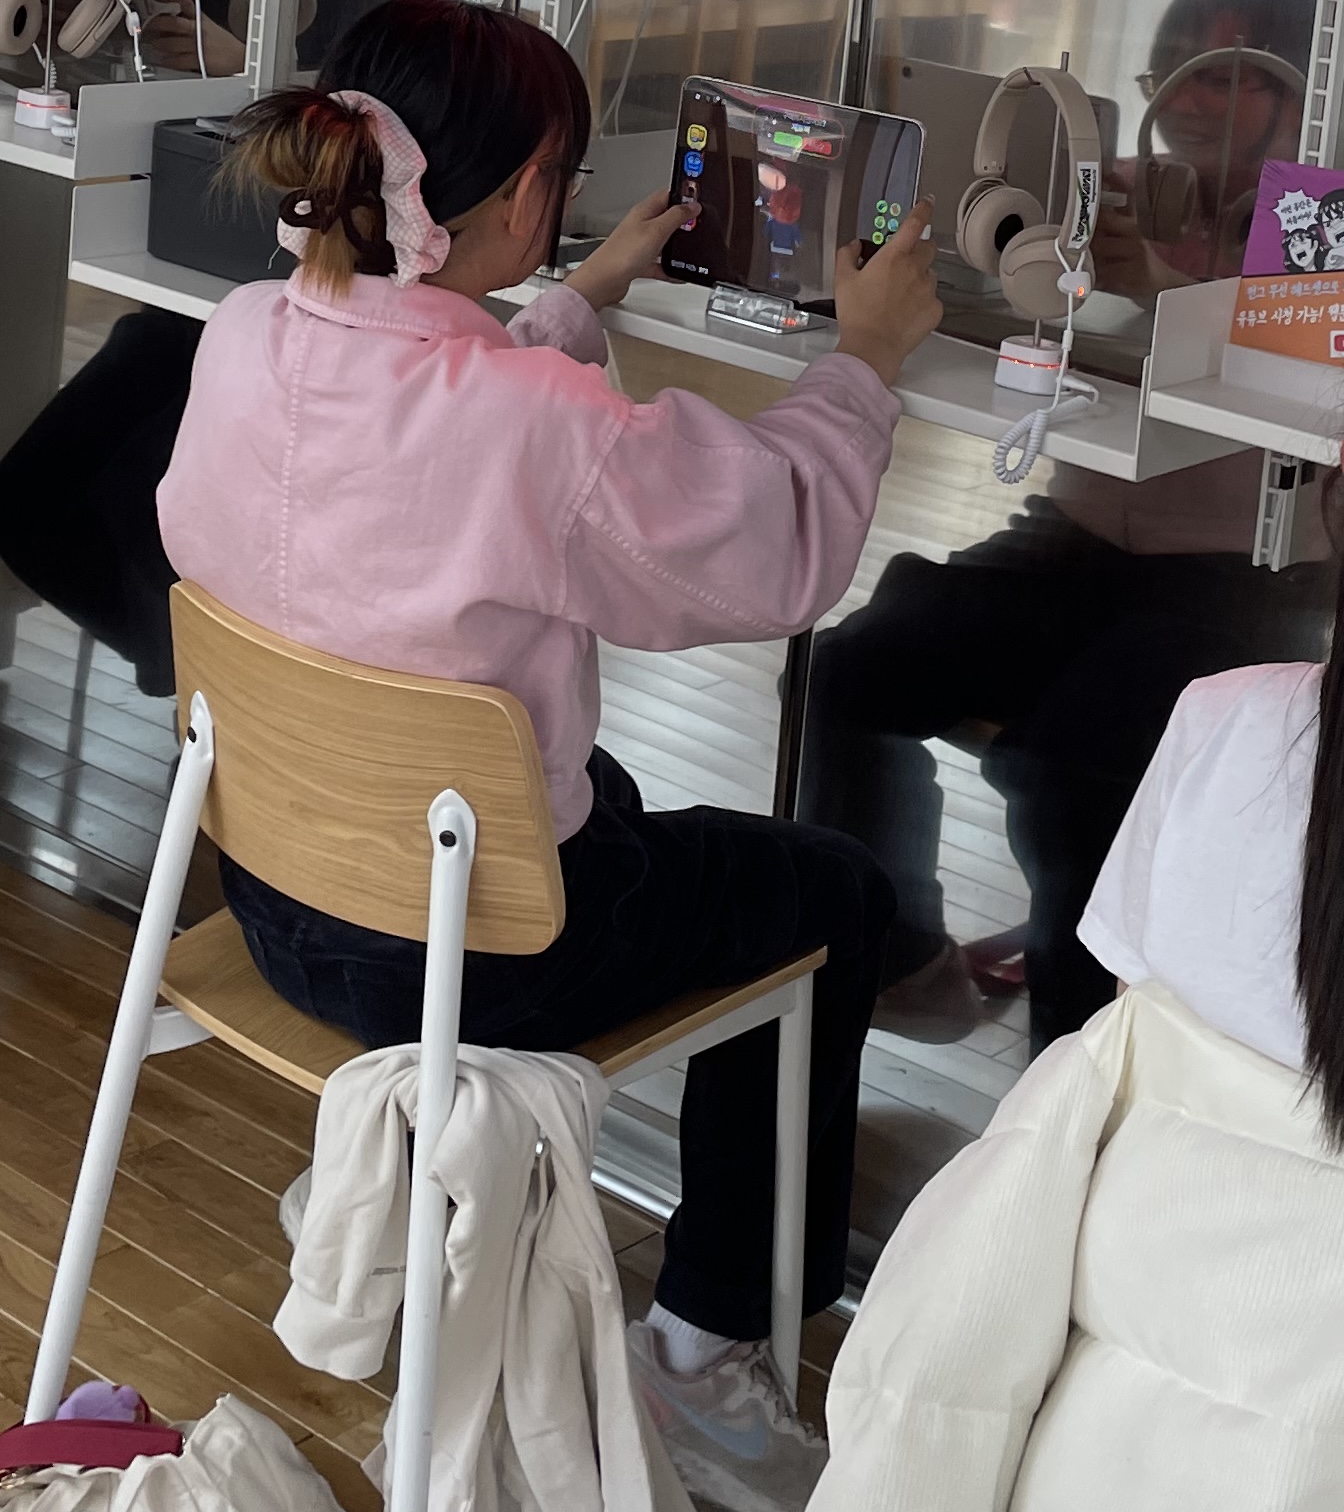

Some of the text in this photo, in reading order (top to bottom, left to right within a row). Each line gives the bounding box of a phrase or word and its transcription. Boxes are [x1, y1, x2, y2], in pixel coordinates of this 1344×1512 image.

[1236, 310, 1268, 328] 유튜브
[1271, 305, 1294, 325] 시청
[1296, 305, 1324, 324] 가능!
